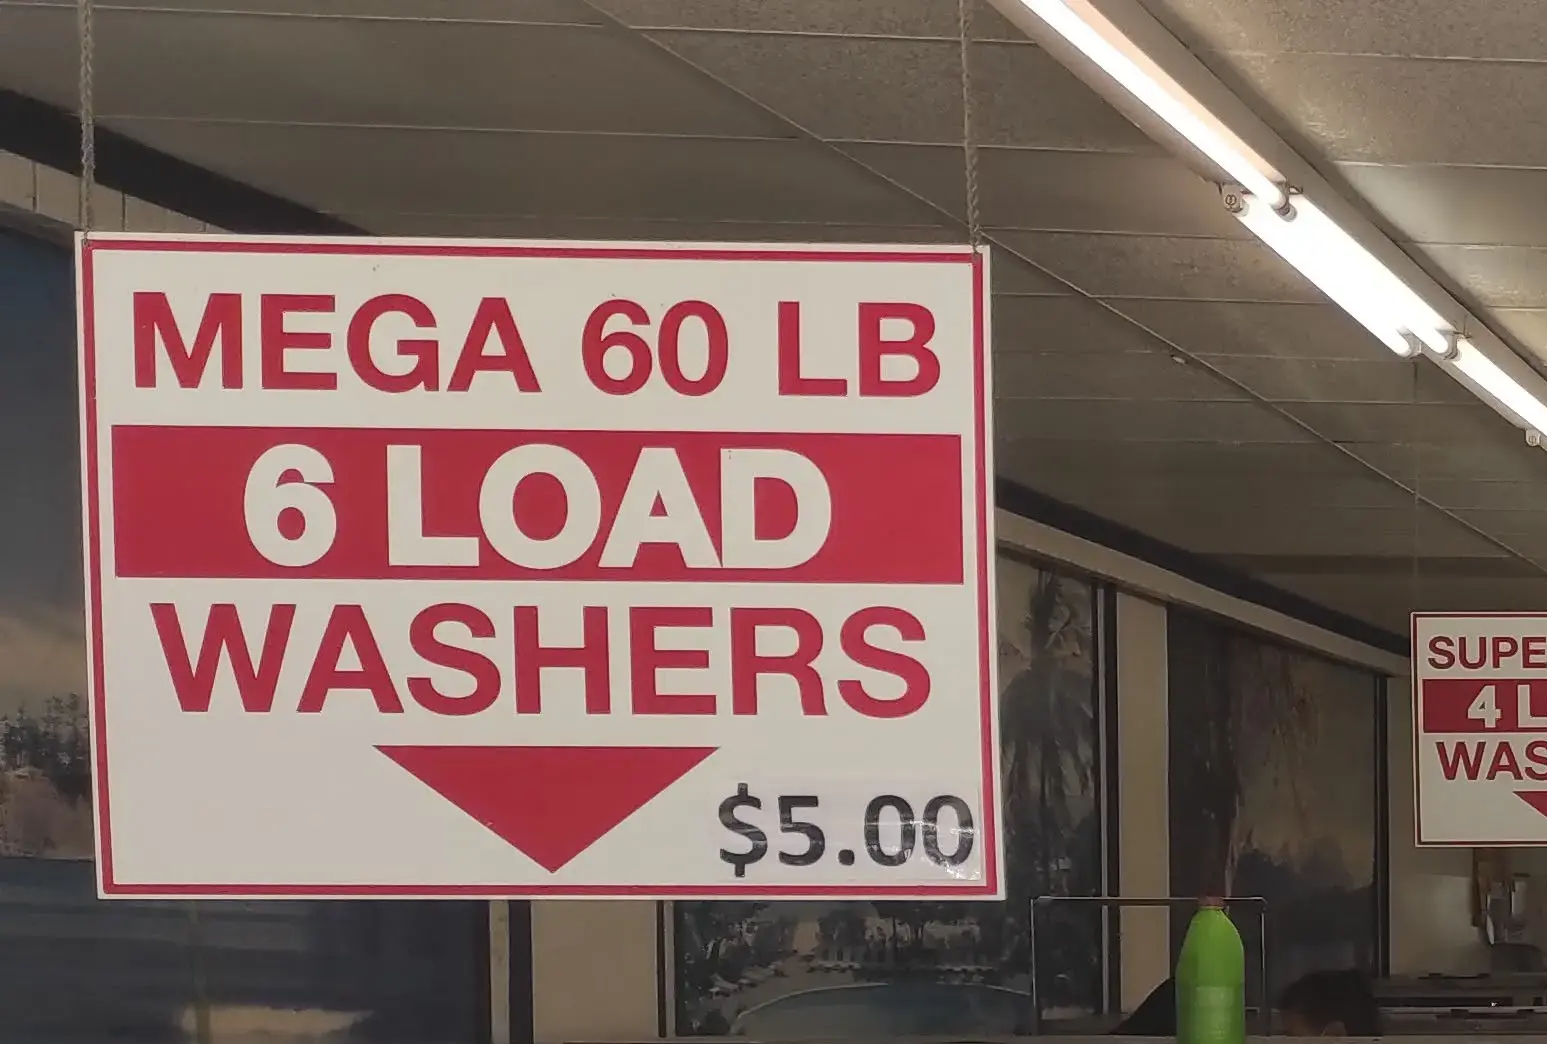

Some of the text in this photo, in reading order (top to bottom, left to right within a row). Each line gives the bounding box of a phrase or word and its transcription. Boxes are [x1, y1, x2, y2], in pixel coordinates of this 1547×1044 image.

[133, 292, 941, 399] MEGA 60 LB
[243, 443, 833, 570] 6 LOAD
[149, 602, 931, 719] WASHERS
[1467, 685, 1501, 728] 4
[716, 782, 975, 878] $5.00
